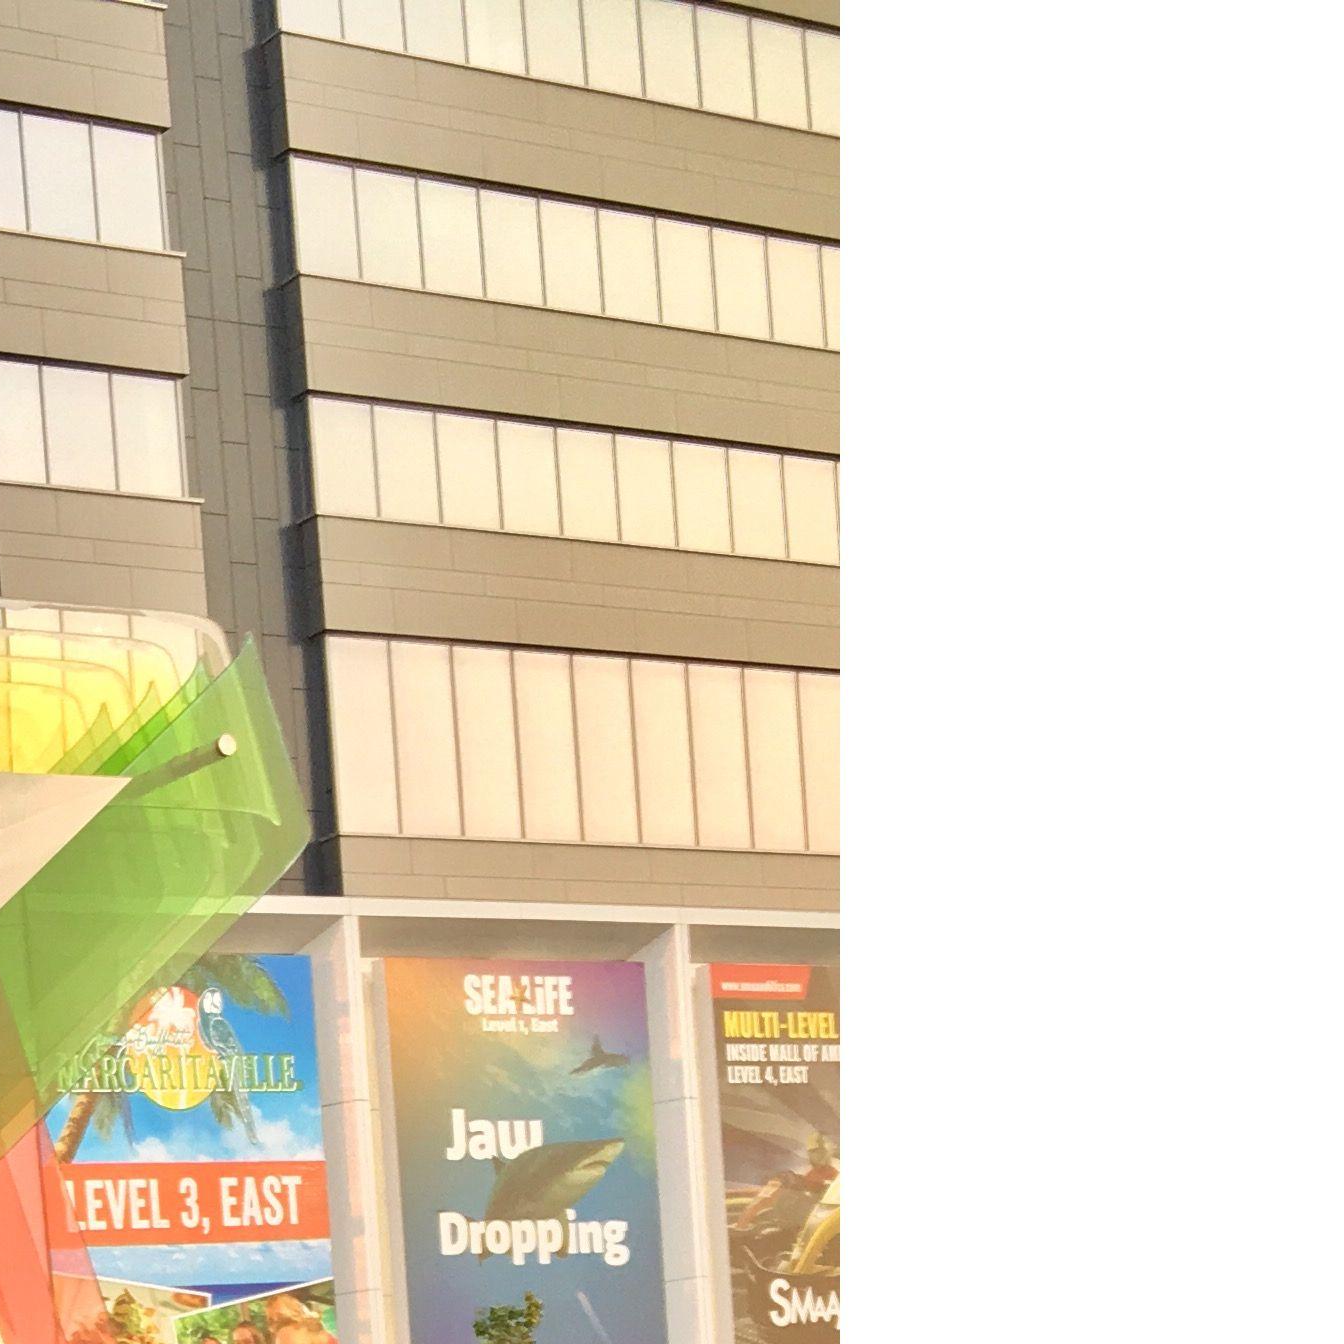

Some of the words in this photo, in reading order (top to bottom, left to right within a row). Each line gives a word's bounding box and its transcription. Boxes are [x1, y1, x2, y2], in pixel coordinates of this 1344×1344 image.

[463, 973, 517, 1016] SEA
[723, 1010, 839, 1039] MULTI-LEVEL
[727, 1065, 764, 1084] LEVEL
[779, 1065, 810, 1084] EAST
[445, 1107, 544, 1162] Jaw
[64, 1177, 170, 1233] LEVEL
[178, 1176, 210, 1235] 3,
[219, 1174, 302, 1227] EAST
[438, 1207, 631, 1267] Dropping
